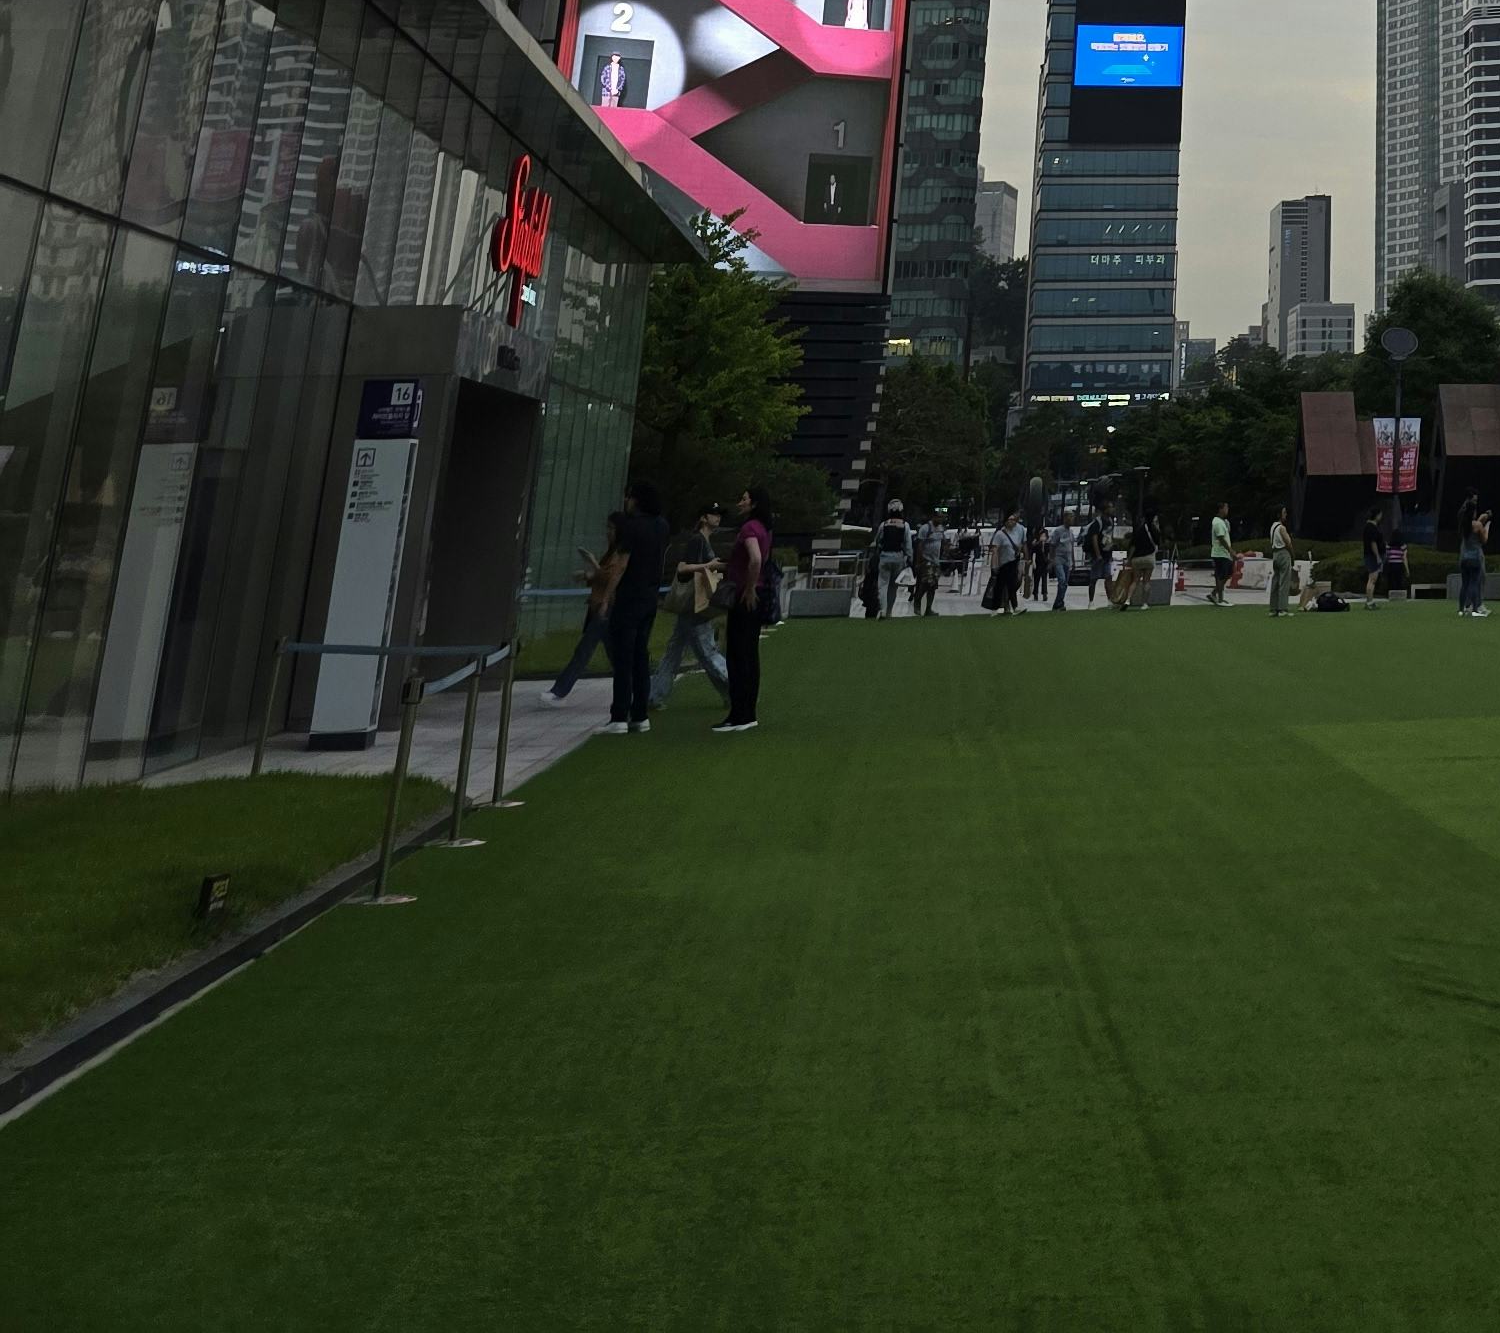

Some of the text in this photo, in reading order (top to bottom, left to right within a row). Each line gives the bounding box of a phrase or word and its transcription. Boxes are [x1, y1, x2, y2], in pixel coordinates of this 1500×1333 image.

[610, 2, 634, 33] 2
[832, 119, 847, 149] 1
[1090, 254, 1165, 265] 더마주 피부과
[395, 386, 410, 402] 16
